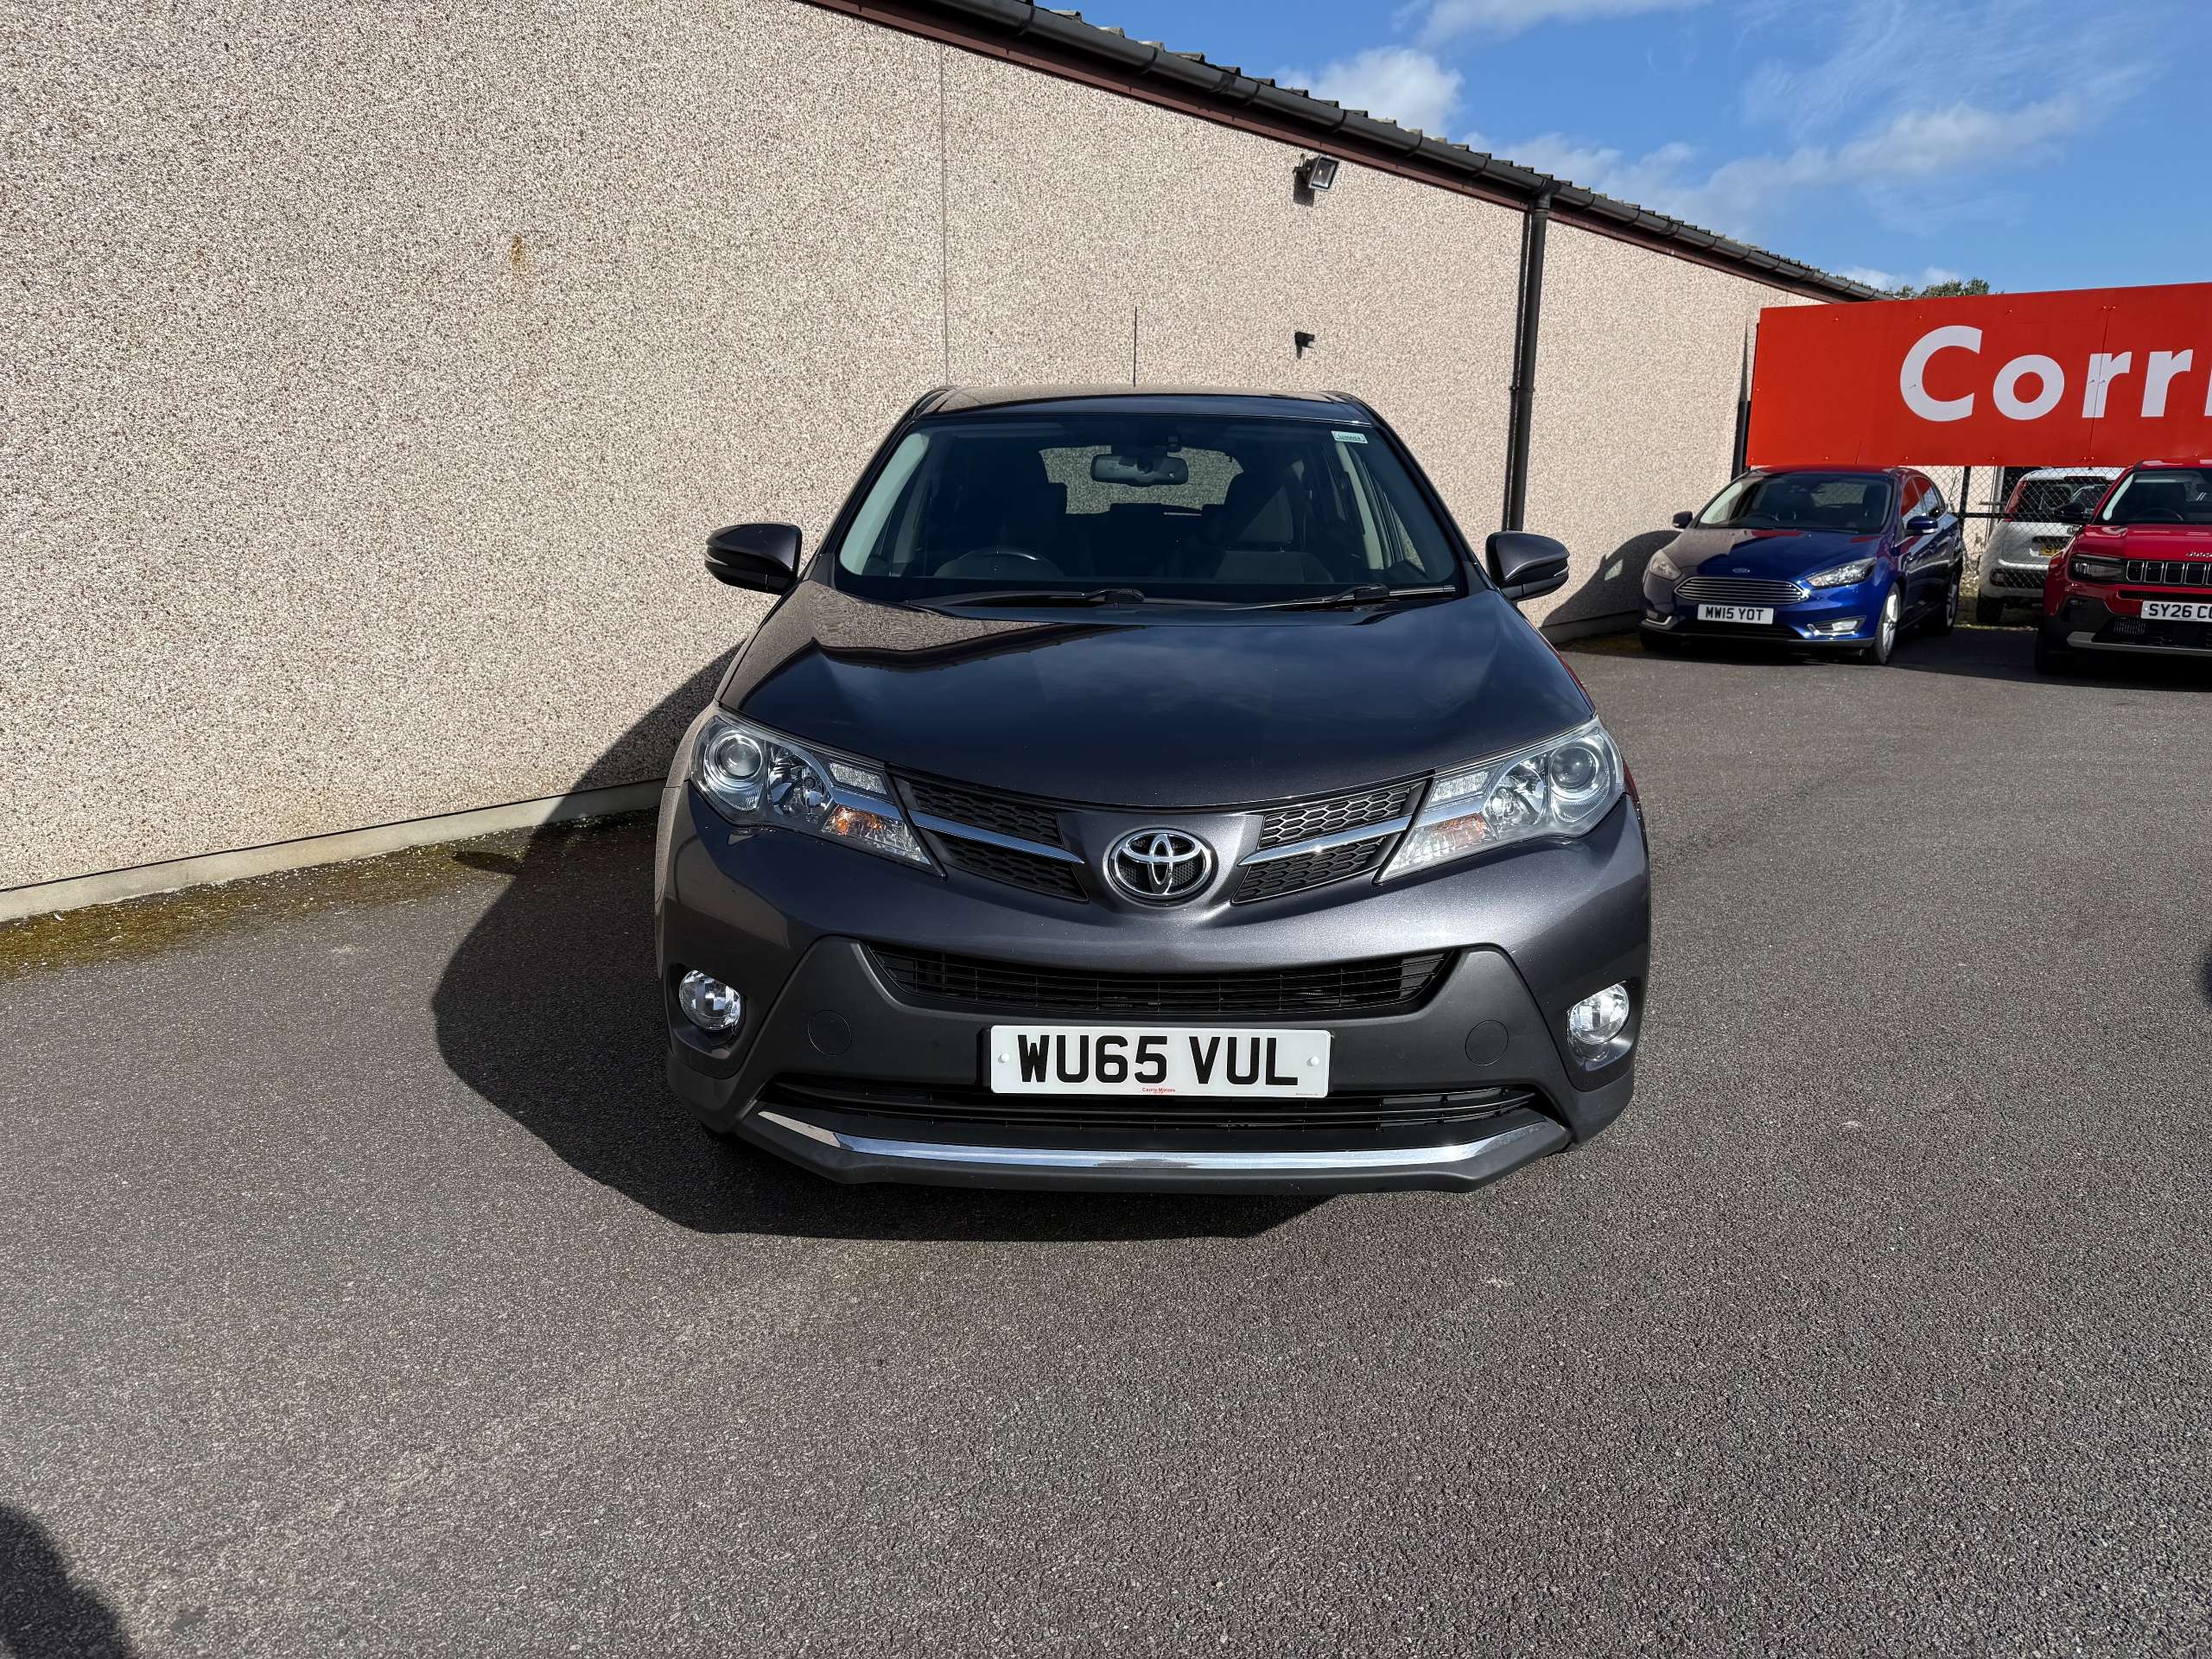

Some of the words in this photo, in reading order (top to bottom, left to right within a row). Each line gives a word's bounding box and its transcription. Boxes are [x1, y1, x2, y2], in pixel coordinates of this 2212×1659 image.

[1899, 325, 2212, 422] Corr
[1706, 607, 1734, 620] MW15
[1738, 607, 1764, 621] YOT
[2148, 603, 2192, 618] SY26
[1017, 1034, 1167, 1084] WU65
[1189, 1036, 1299, 1085] VUL
